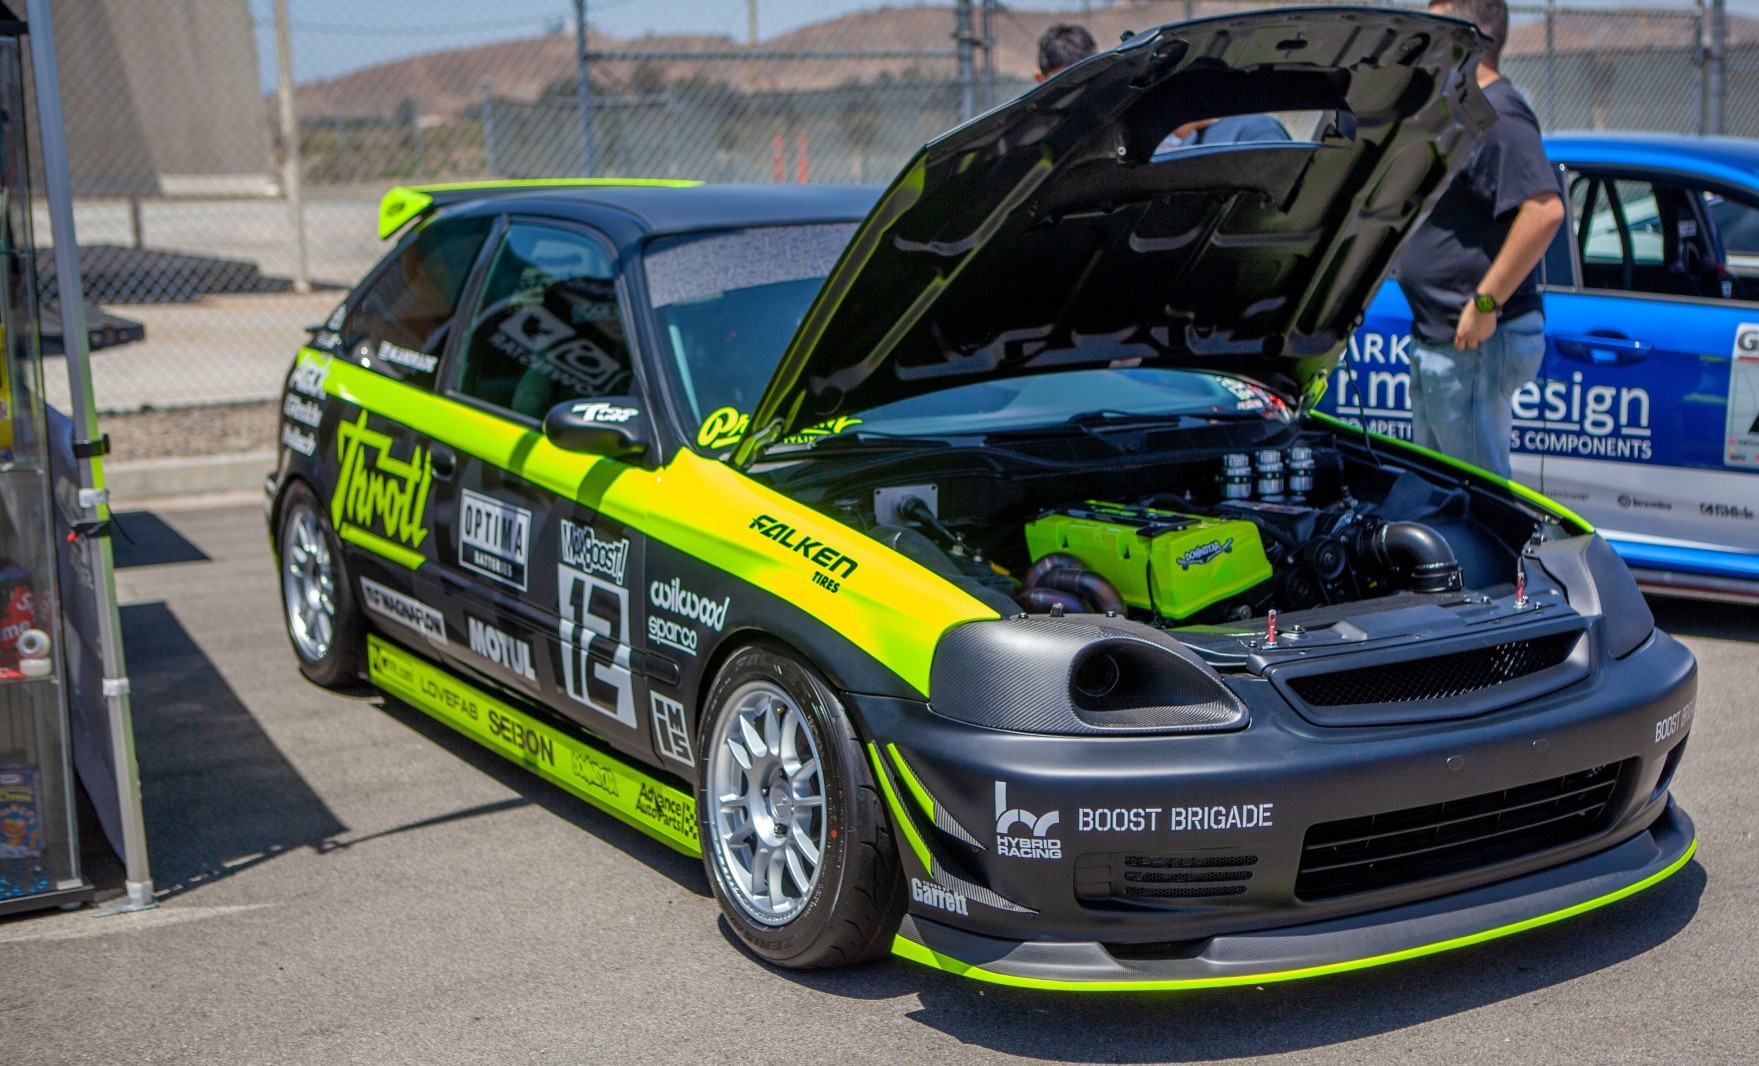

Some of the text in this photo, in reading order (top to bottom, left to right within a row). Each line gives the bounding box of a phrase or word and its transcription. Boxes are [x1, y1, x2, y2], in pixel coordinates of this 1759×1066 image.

[1511, 371, 1651, 435] esign
[1524, 431, 1652, 459] COMPONENTS
[465, 505, 524, 559] OPTIMA
[749, 515, 858, 579] FALKEN
[474, 550, 513, 578] BATTERIES
[812, 571, 840, 593] TIRES
[650, 577, 730, 631] wilwood
[468, 616, 536, 681] MOTUL
[648, 615, 697, 650] sparco
[420, 676, 479, 721] LOVEFAB
[487, 710, 555, 768] SEIBON
[1655, 710, 1682, 743] BOOST
[640, 782, 681, 816] Advance
[1078, 803, 1273, 832] BOOST BRIGADE
[997, 836, 1061, 849] HYBRID
[997, 846, 1062, 859] RACING
[911, 878, 968, 916] Garrett
